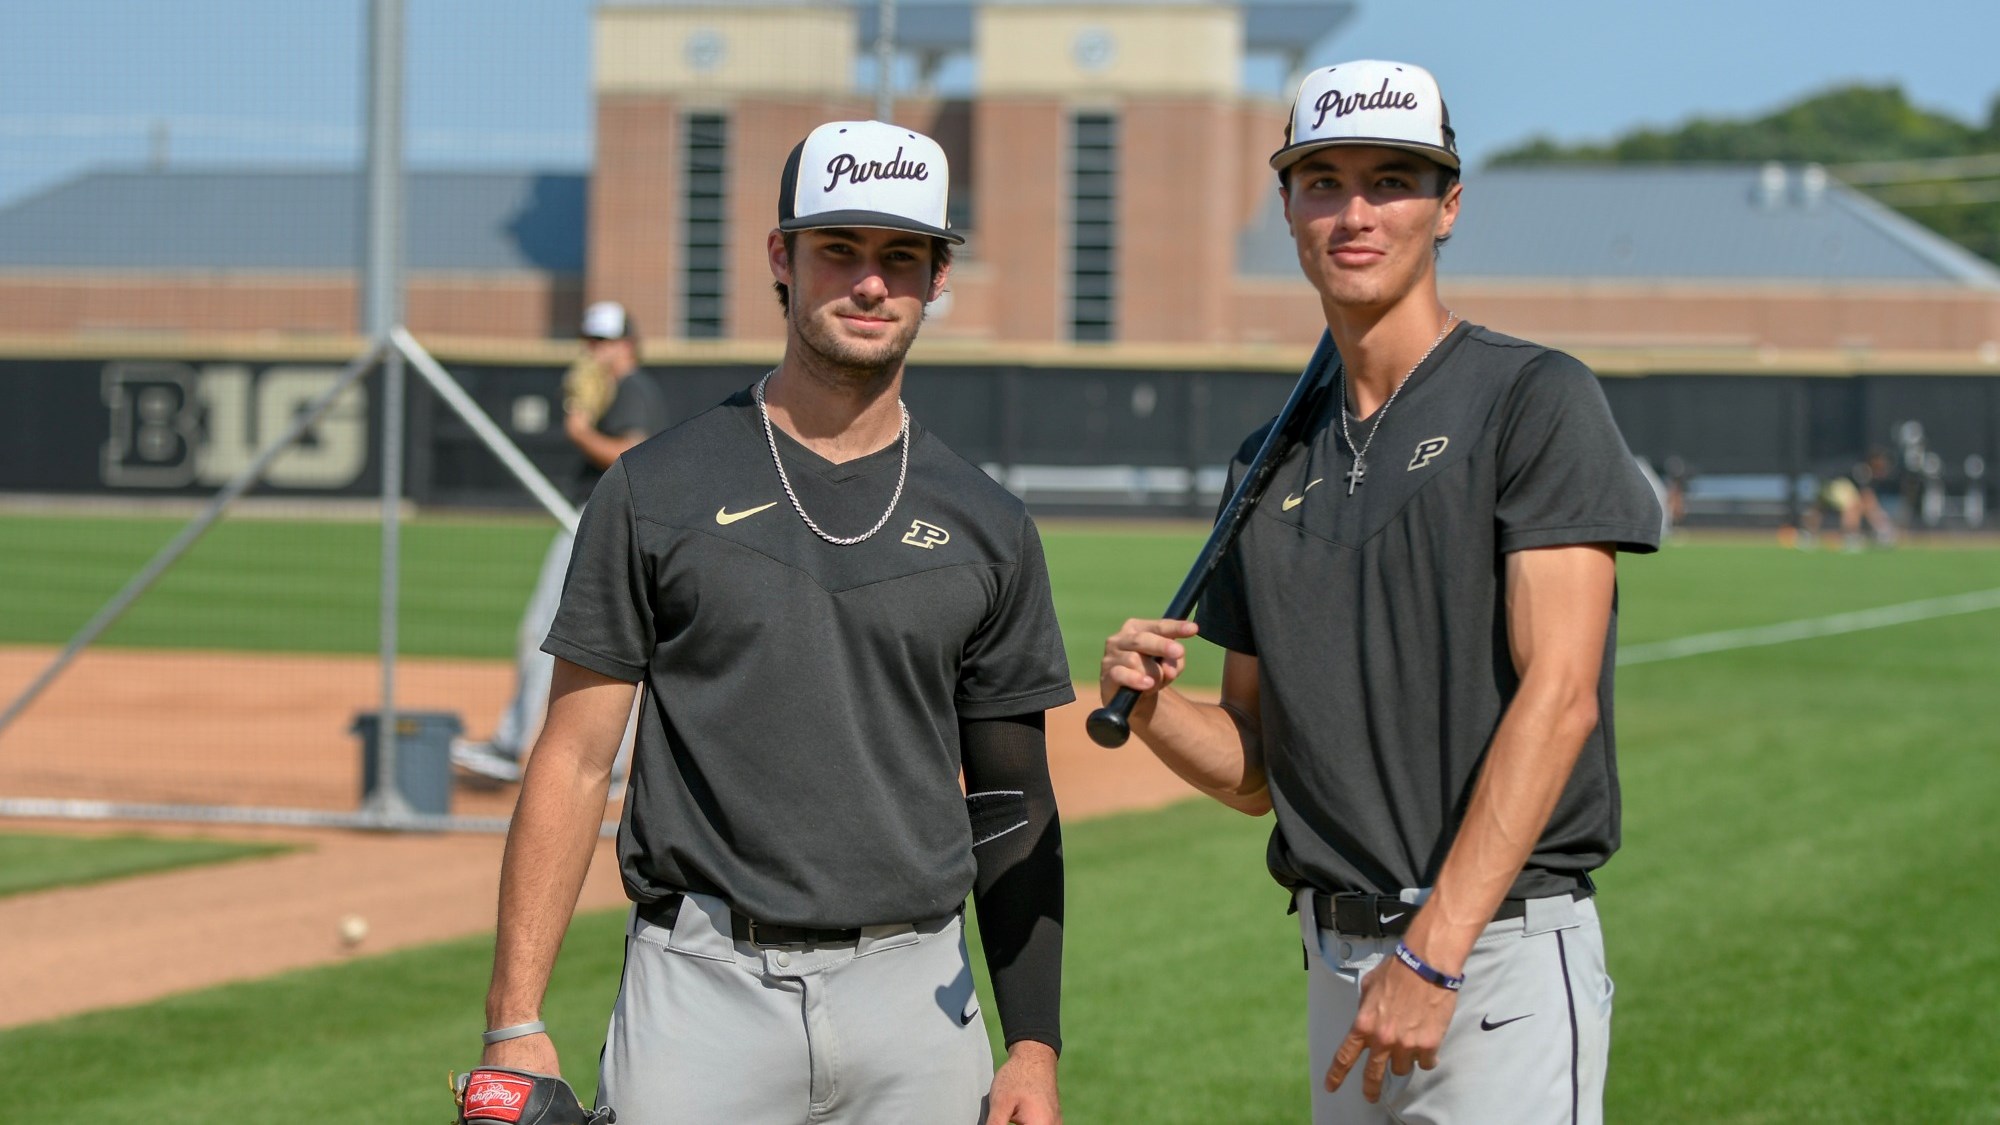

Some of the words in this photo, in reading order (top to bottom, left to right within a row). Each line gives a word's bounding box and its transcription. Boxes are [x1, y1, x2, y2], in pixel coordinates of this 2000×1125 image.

[1311, 77, 1418, 130] Purdue
[823, 146, 929, 193] Purdue
[469, 1085, 521, 1106] Rawlings
